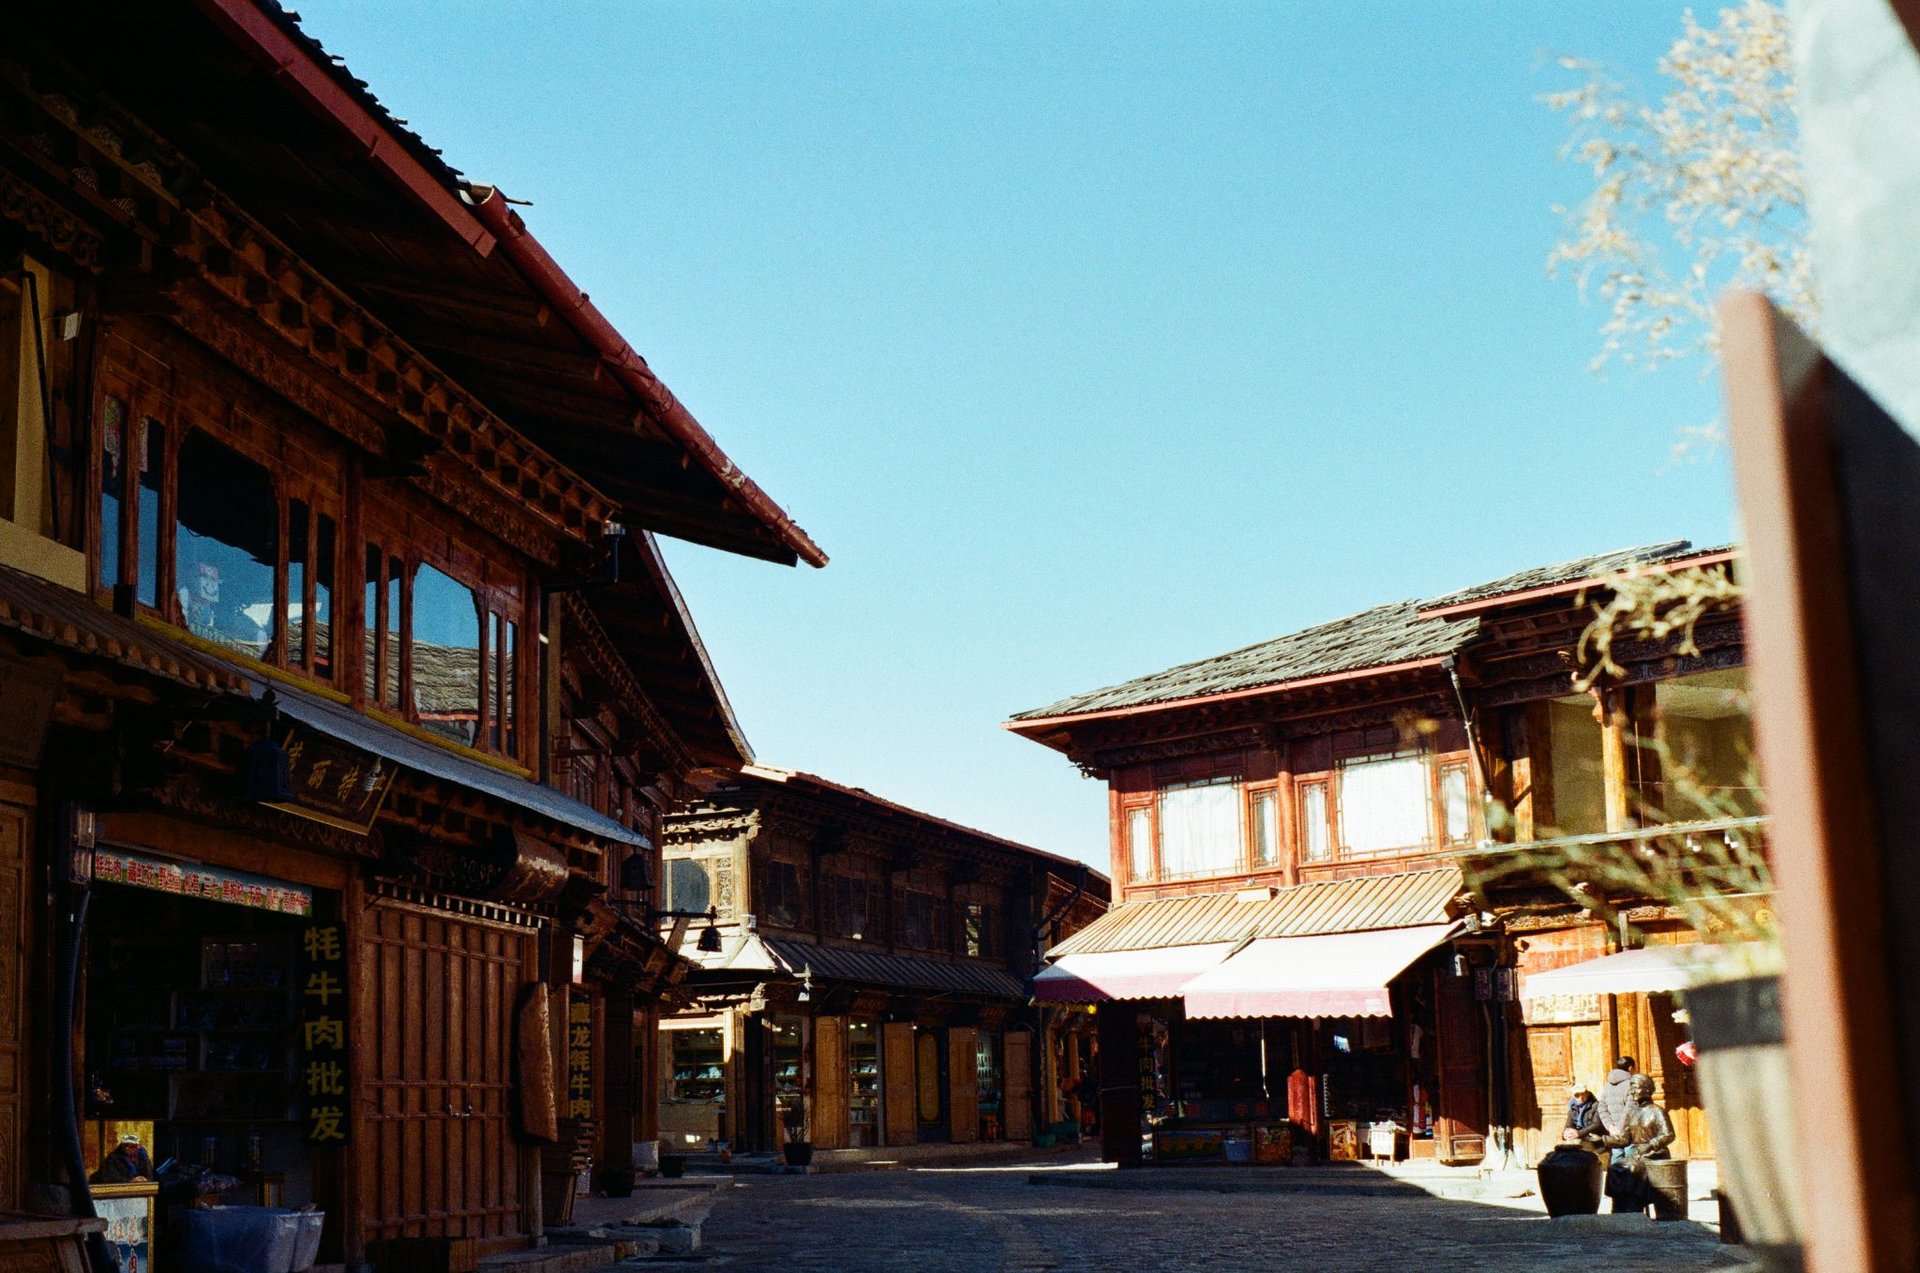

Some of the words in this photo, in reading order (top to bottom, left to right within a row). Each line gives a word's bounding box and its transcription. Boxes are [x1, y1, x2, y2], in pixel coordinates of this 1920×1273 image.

[304, 925, 346, 1142] 牦牛肉批发
